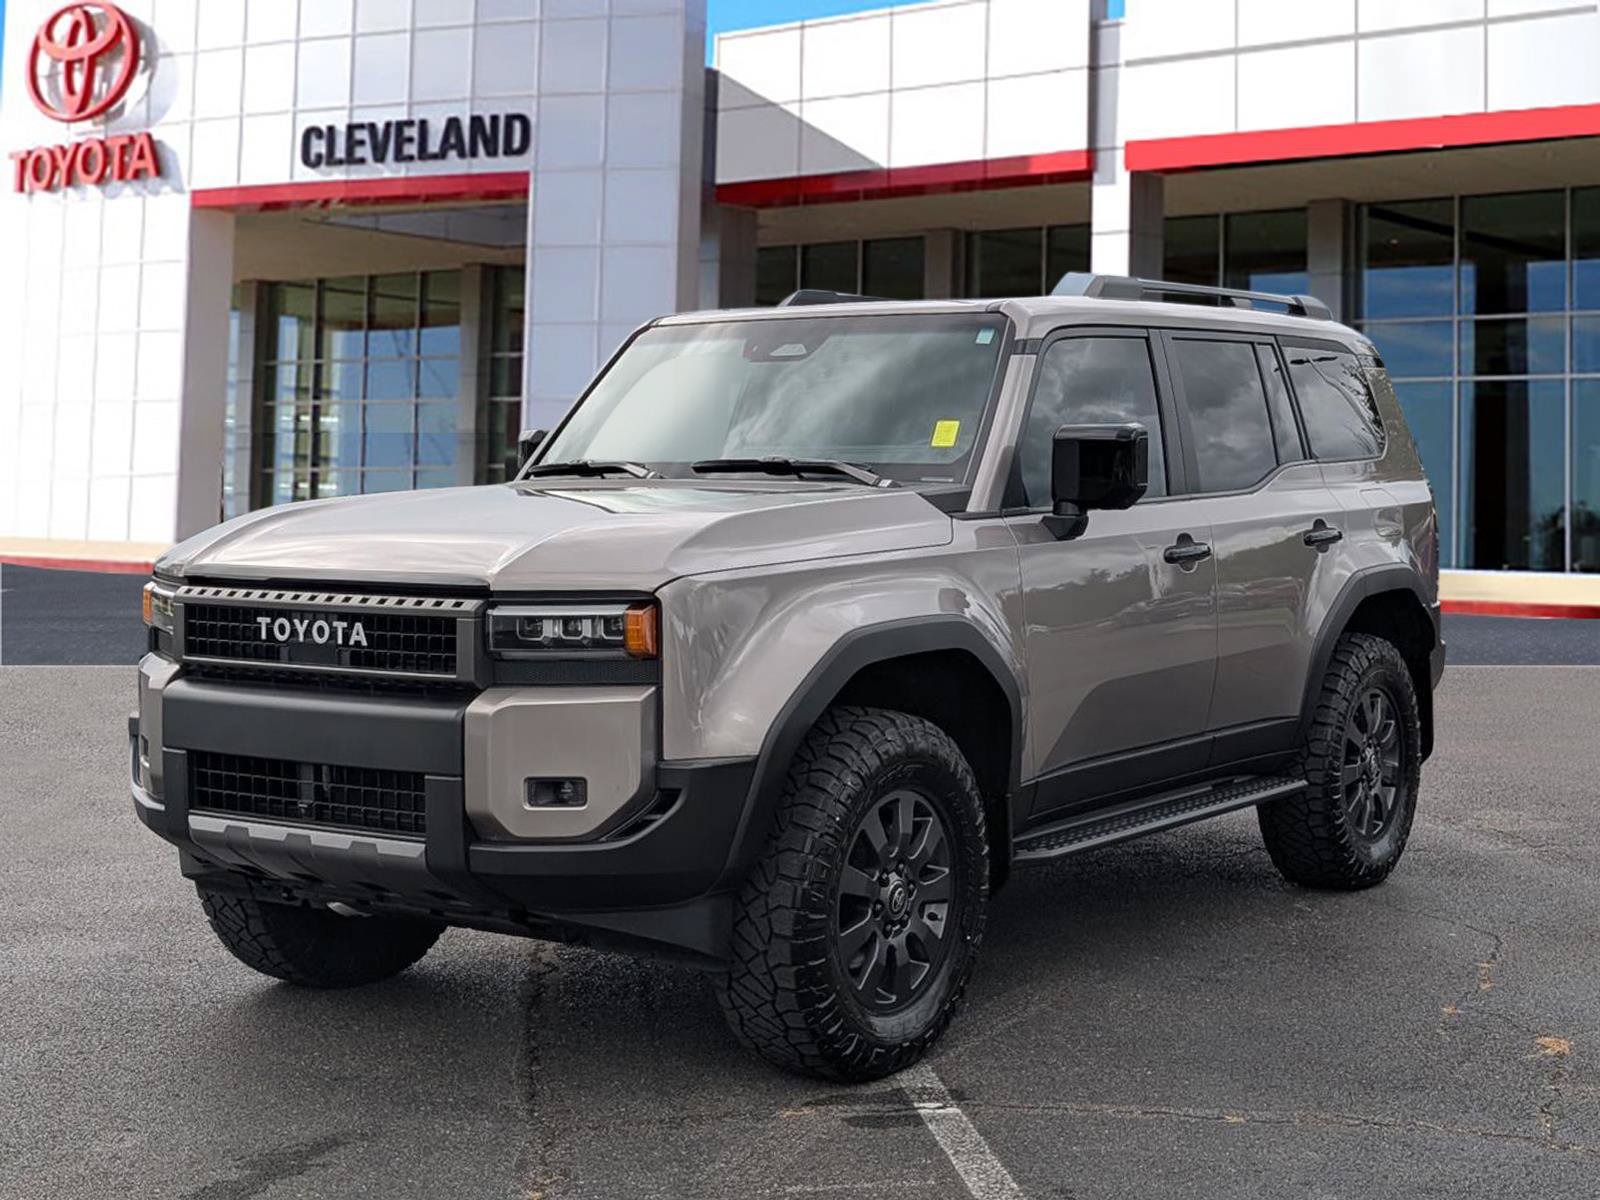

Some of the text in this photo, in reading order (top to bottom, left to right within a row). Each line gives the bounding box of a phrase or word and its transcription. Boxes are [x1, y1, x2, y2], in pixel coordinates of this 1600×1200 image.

[9, 132, 160, 193] TOYOTA
[301, 113, 531, 169] CLEVELAND
[256, 616, 368, 647] TOYOTA
